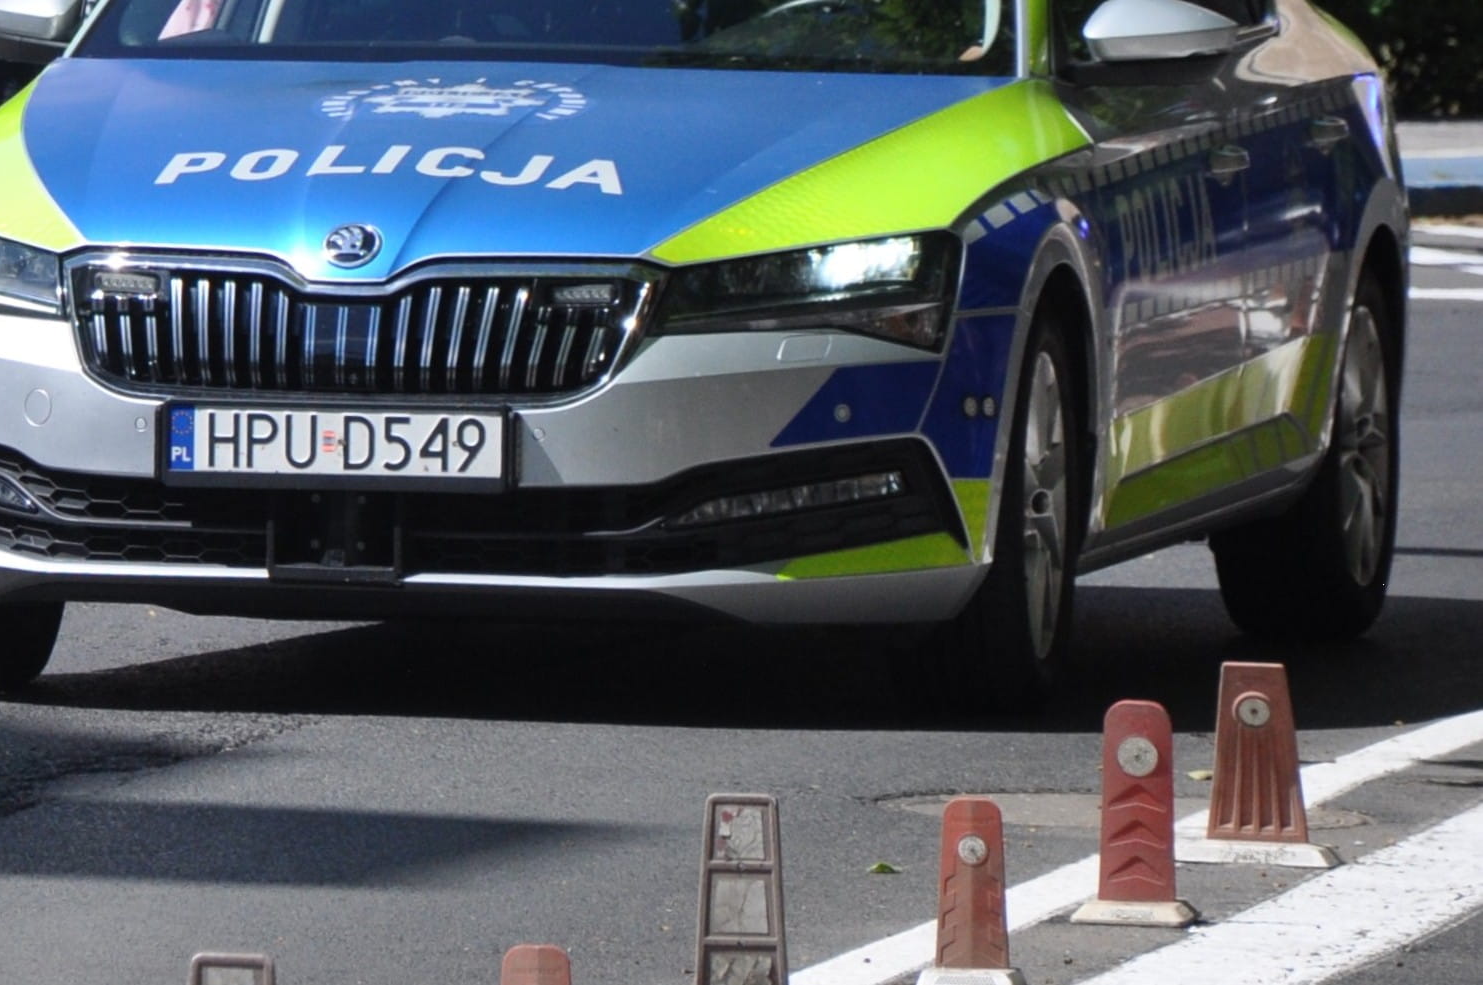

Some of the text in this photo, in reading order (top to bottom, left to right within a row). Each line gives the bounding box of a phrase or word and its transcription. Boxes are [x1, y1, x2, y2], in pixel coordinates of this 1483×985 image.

[154, 145, 623, 195] POLICJA
[171, 445, 192, 463] PL
[206, 411, 486, 472] HPU D549
